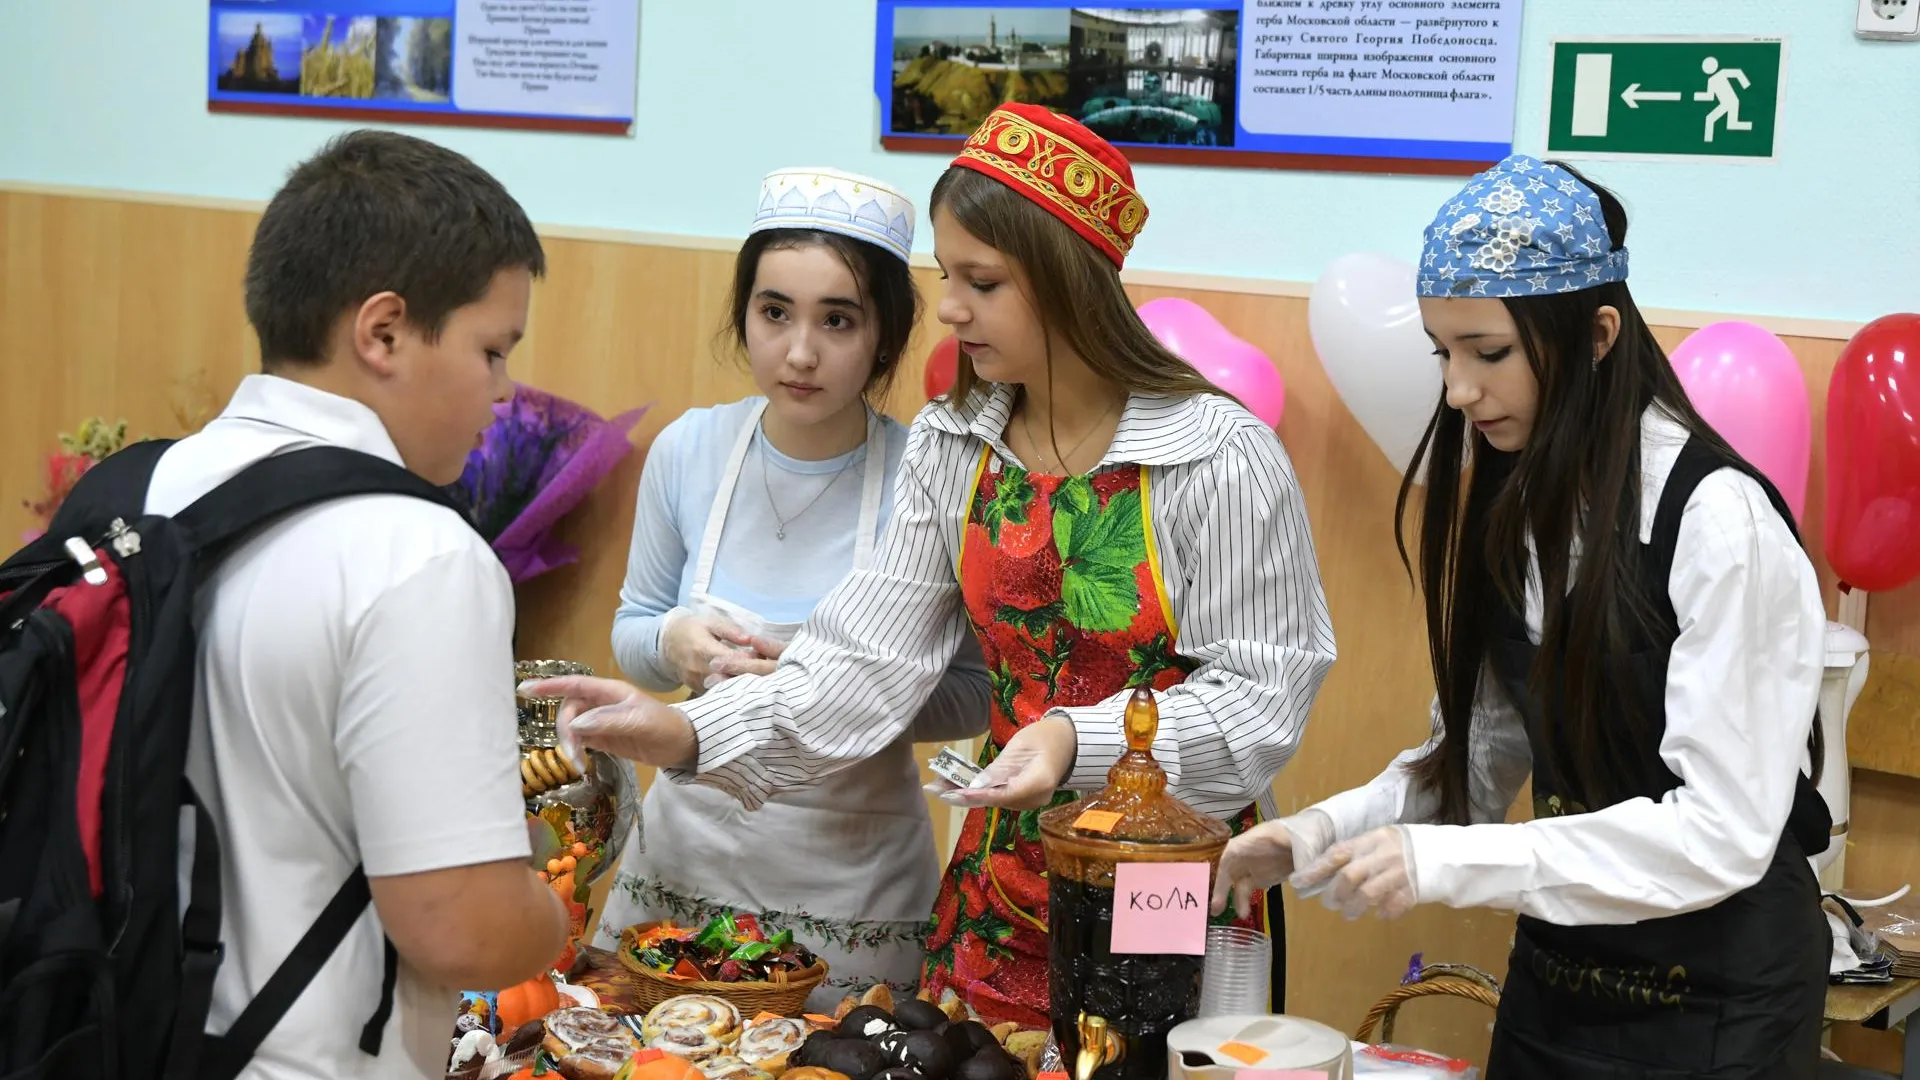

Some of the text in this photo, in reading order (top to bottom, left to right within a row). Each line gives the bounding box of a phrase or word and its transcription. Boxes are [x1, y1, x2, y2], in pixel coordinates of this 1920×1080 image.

[1320, 0, 1355, 12] древку
[1361, 1, 1383, 12] углу
[1388, 1, 1445, 9] основного
[1451, 1, 1500, 9] элемента
[1256, 14, 1283, 28] герба
[1286, 14, 1350, 26] Московской
[1354, 15, 1396, 26] области
[1416, 17, 1488, 31] развёрнутого
[1255, 32, 1498, 47] древку Святого Георгия Победоносца.
[1255, 48, 1497, 65] Габаритная ширина изображения основного
[1254, 69, 1298, 77] элемента
[1302, 67, 1329, 81] герба
[1348, 68, 1377, 82] флаге
[1382, 69, 1448, 81] Московской
[1452, 70, 1495, 82] области
[1253, 86, 1306, 95] составляет
[1308, 85, 1324, 95] 1/5
[1326, 88, 1352, 96] часть
[1353, 89, 1387, 98] длины
[1389, 90, 1448, 100] полотнища
[1130, 887, 1198, 911] КОЛА
